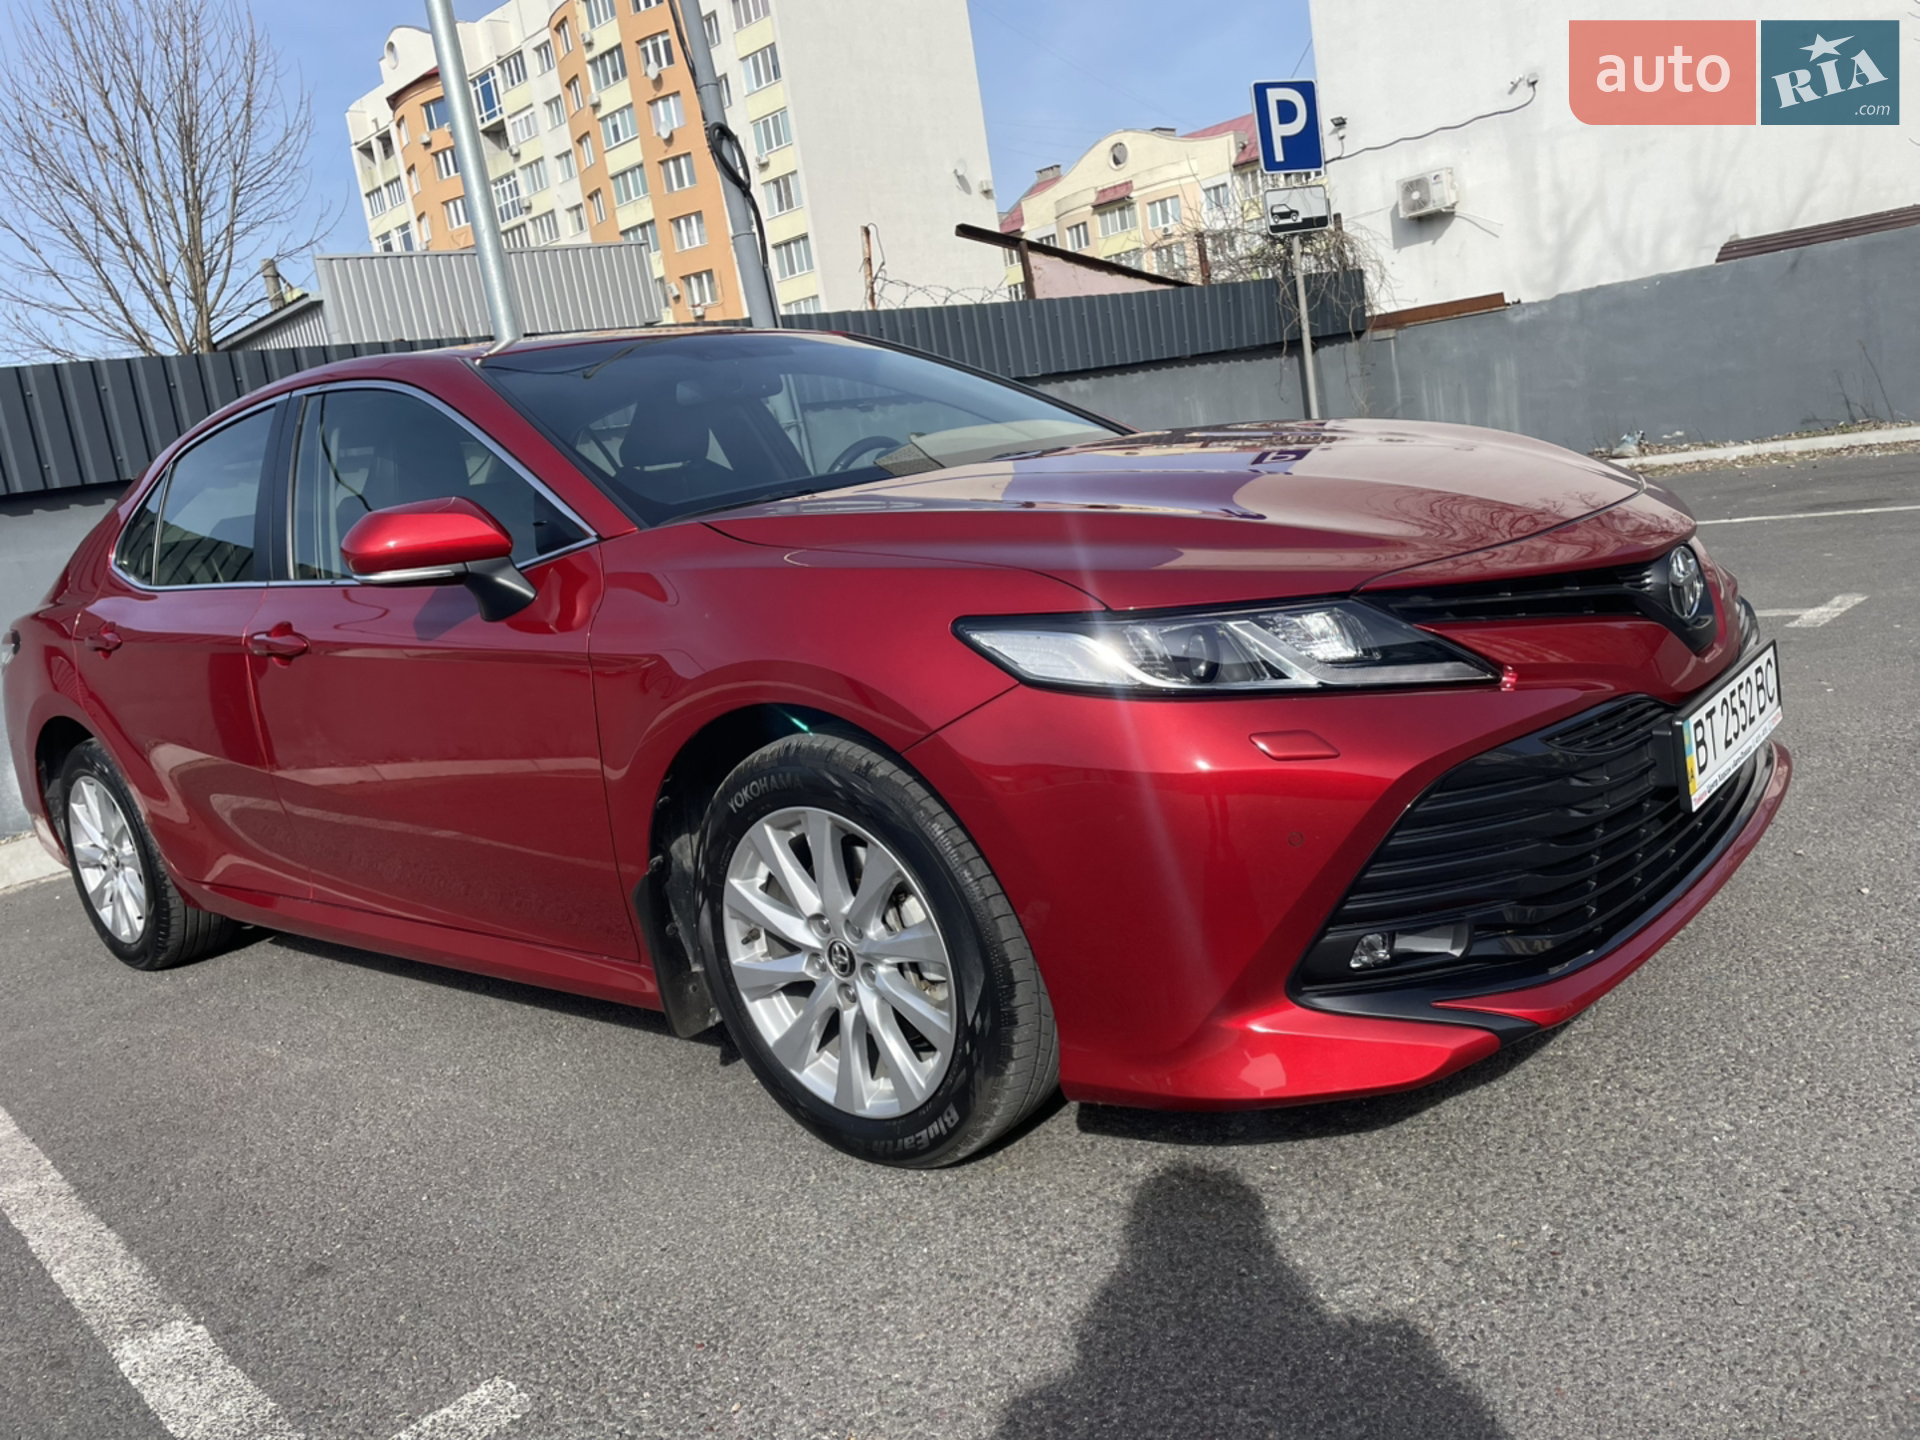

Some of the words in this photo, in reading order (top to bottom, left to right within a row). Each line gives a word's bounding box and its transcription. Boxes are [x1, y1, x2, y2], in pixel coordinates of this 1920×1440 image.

[1266, 87, 1307, 162] P
[1693, 705, 1717, 776] BT
[1720, 676, 1756, 750] 2552
[1755, 657, 1776, 716] BC
[727, 772, 804, 814] YOKOHAMA
